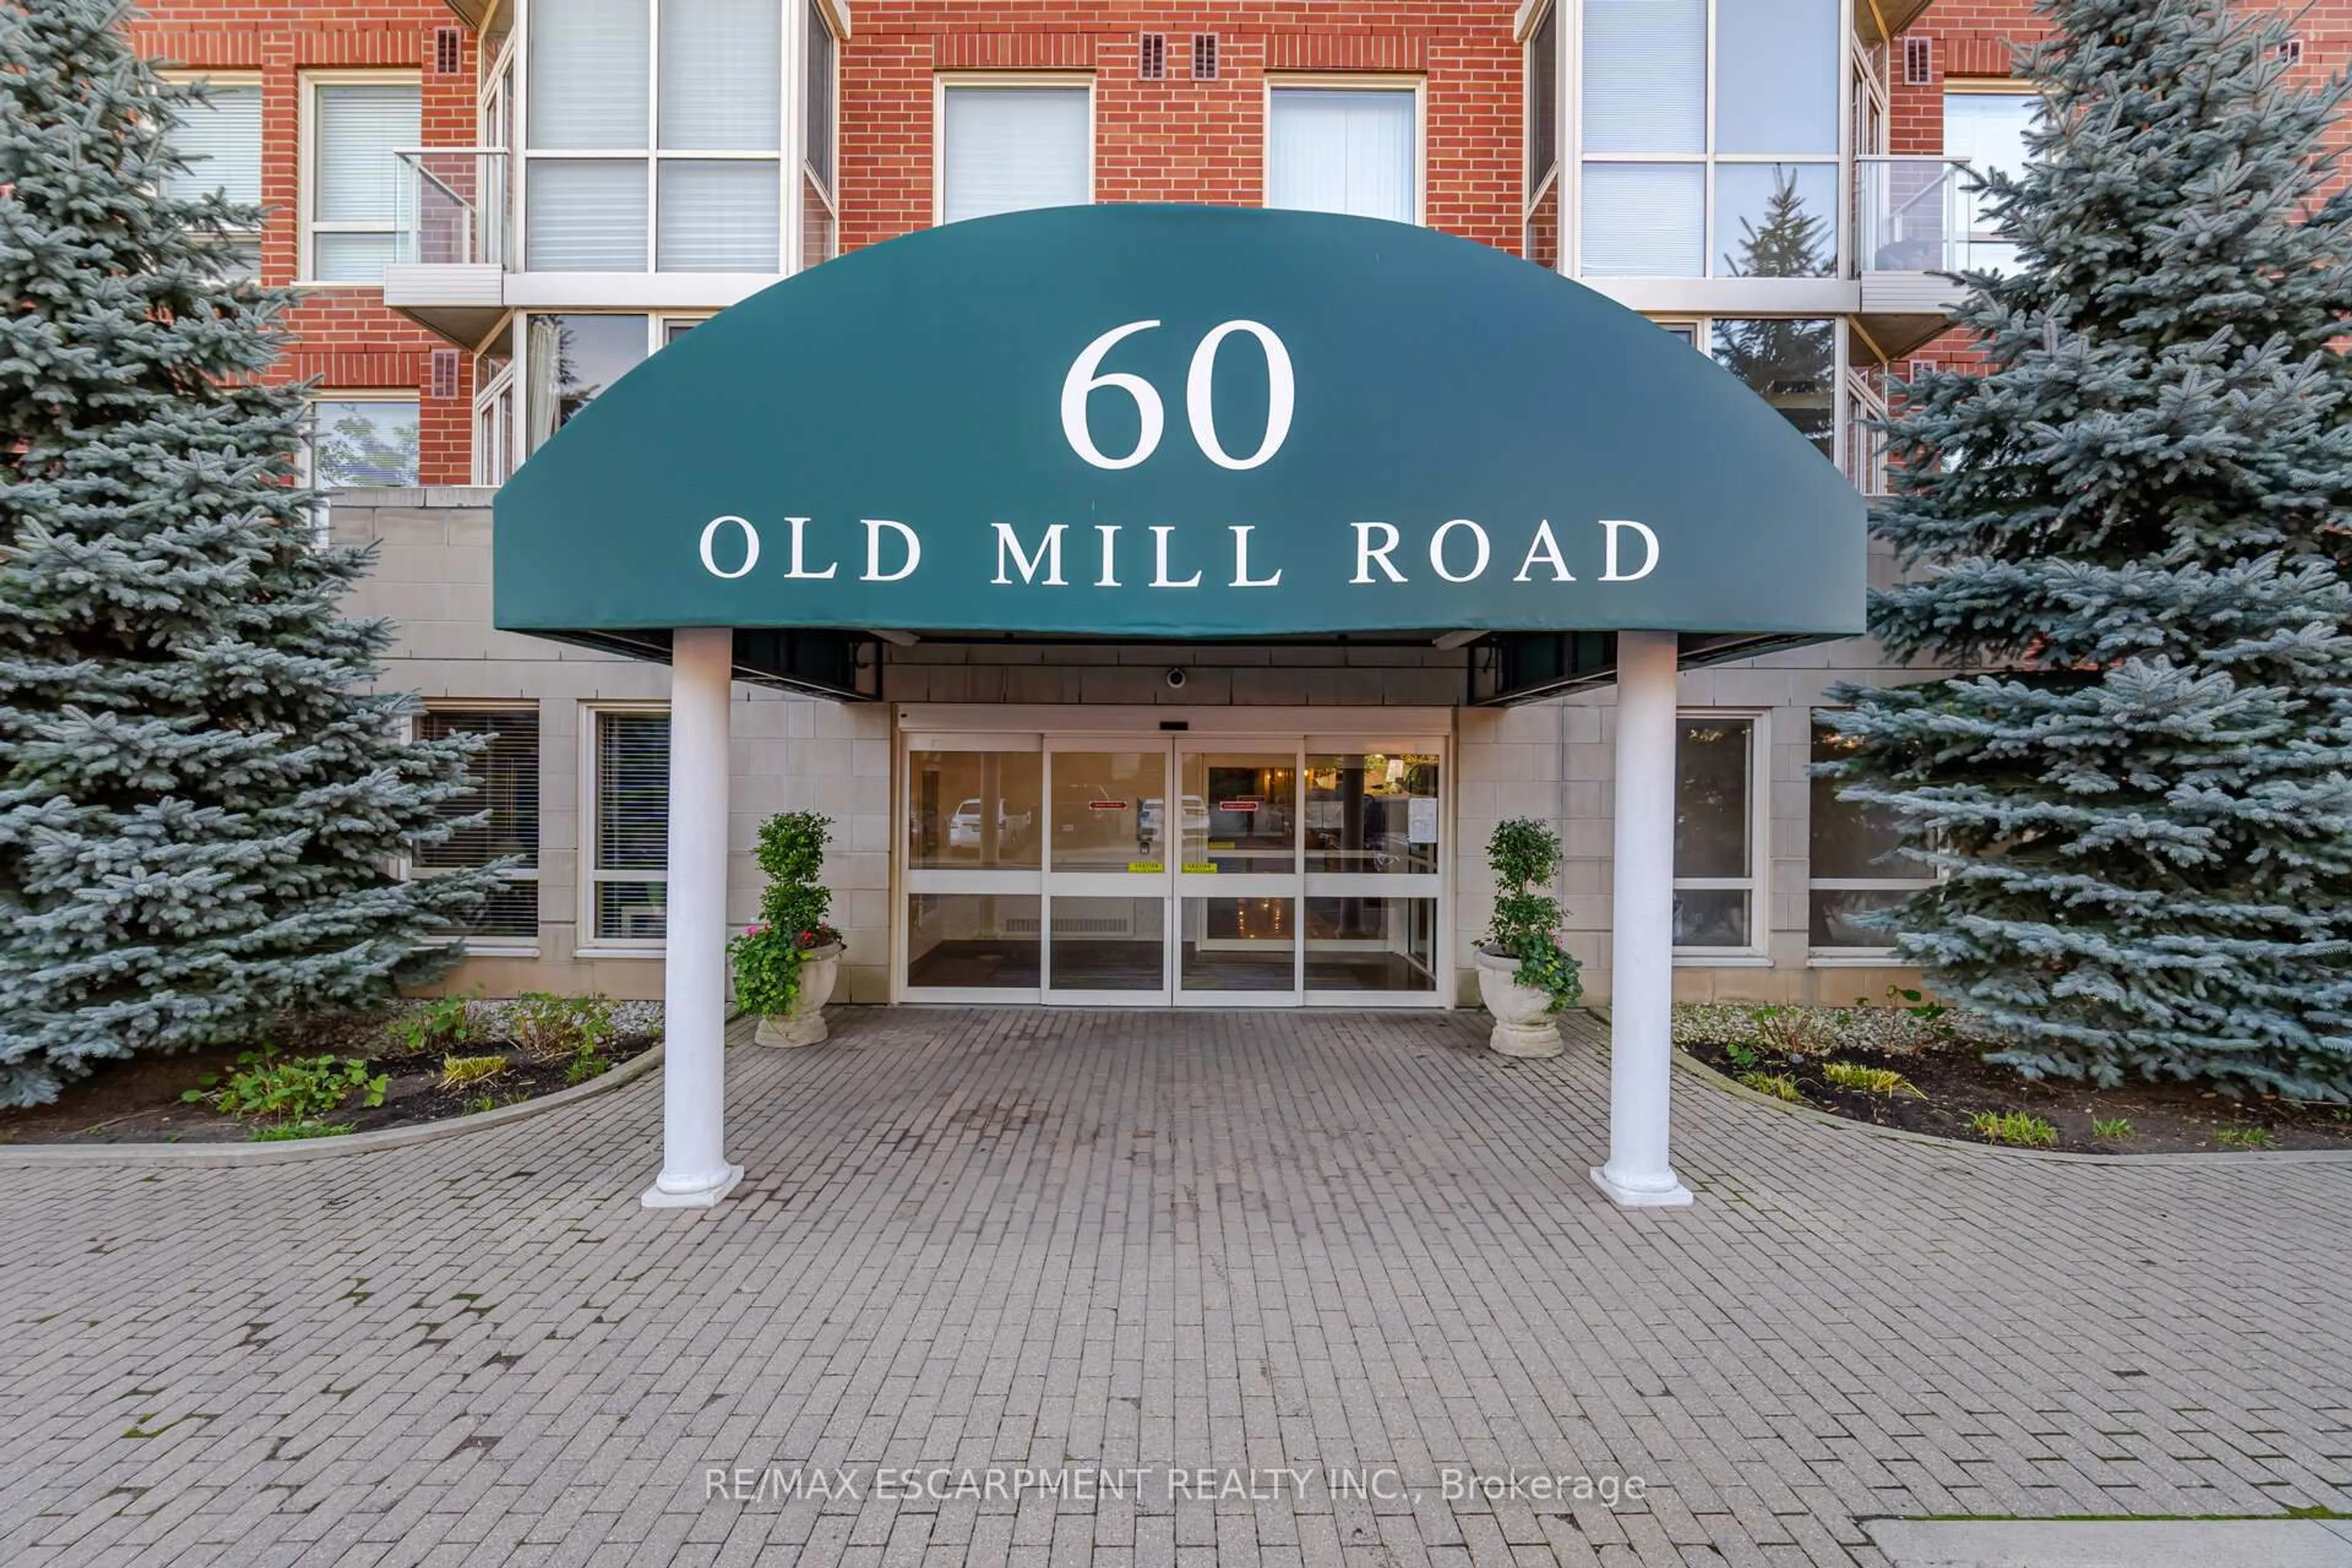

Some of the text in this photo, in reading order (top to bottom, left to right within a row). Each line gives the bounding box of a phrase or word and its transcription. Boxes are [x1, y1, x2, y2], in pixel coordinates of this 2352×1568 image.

[1061, 320, 1295, 470] 60
[699, 515, 1660, 587] OLD MILL ROAD
